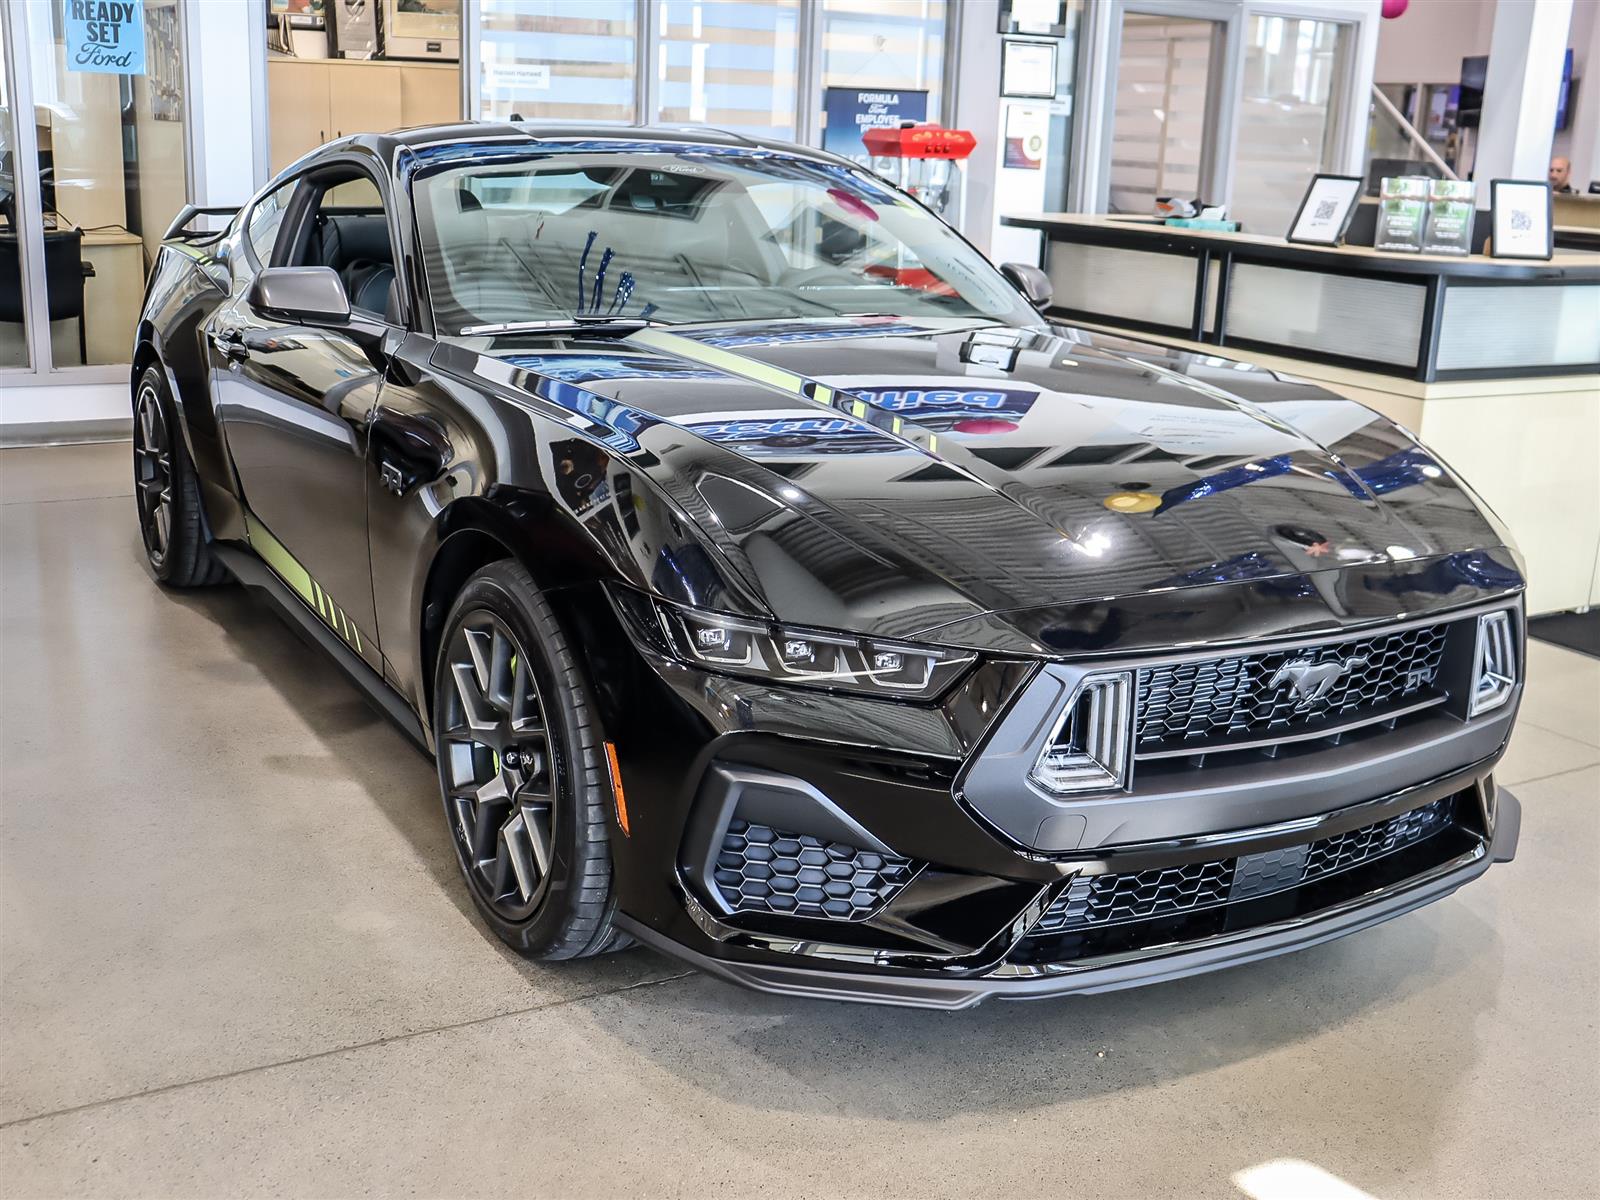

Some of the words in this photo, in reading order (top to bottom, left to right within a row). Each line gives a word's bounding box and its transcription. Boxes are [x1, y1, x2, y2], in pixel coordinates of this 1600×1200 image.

[71, 0, 134, 23] READY
[86, 21, 121, 43] SET
[75, 42, 132, 67] Ford
[857, 92, 899, 105] FORMULA
